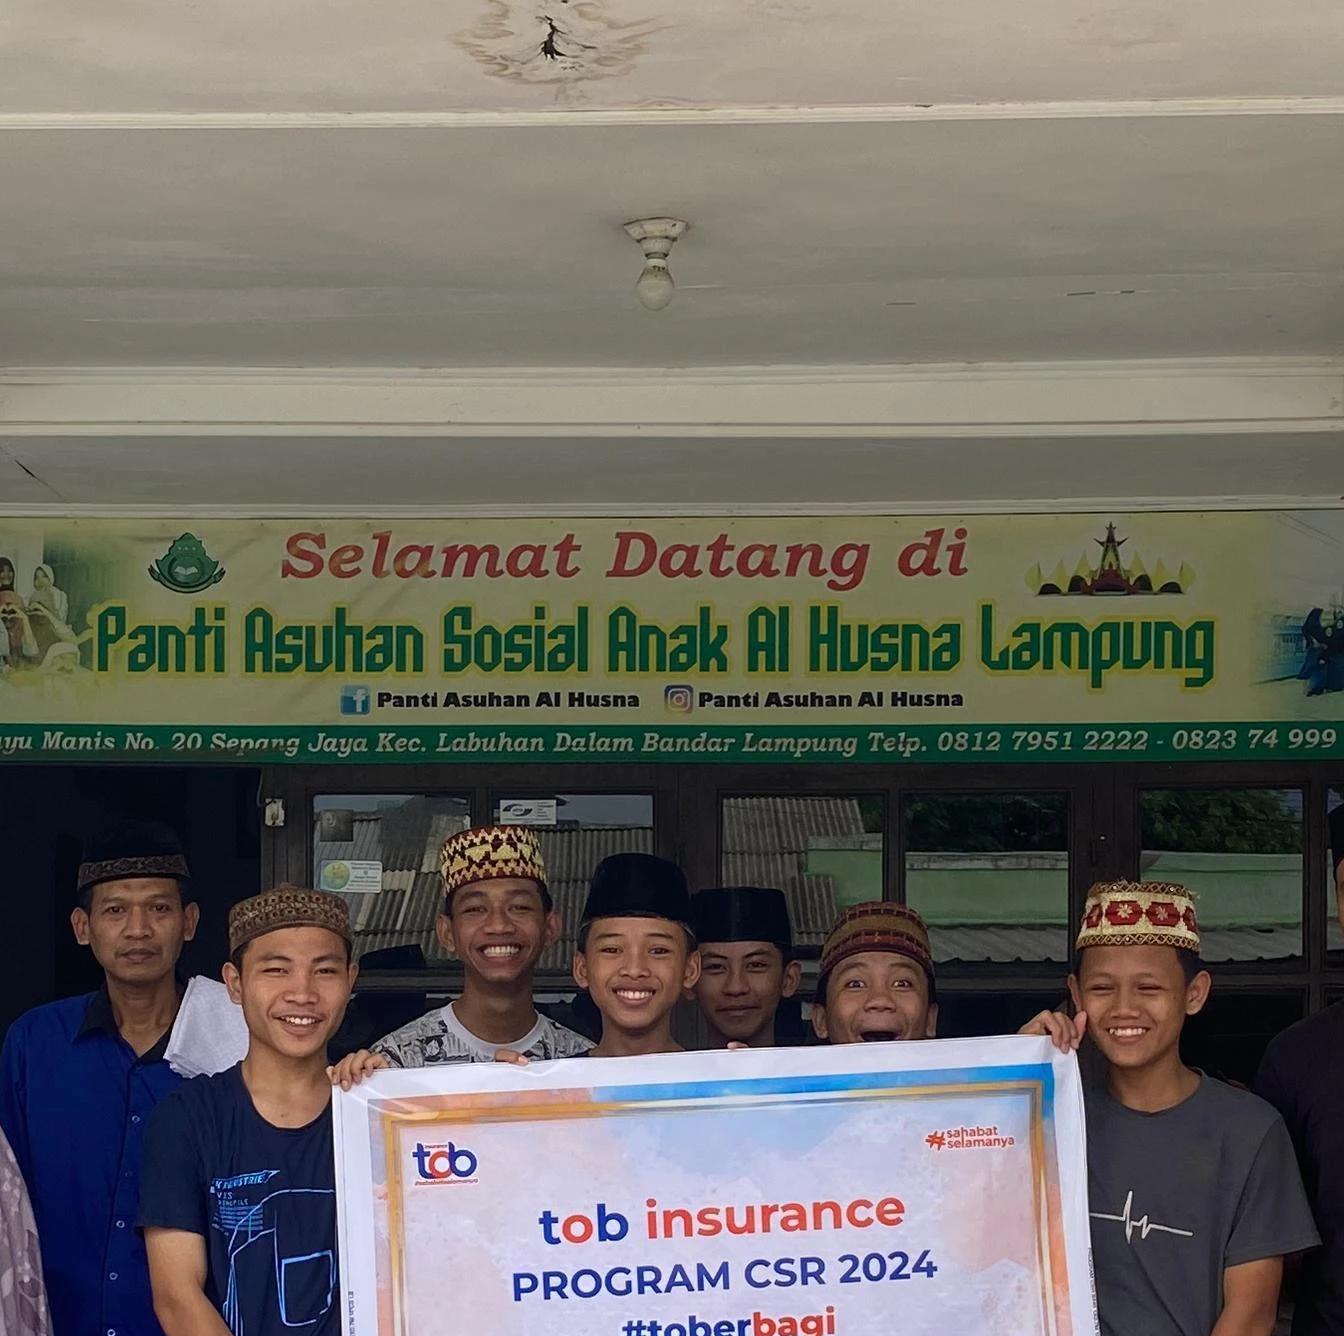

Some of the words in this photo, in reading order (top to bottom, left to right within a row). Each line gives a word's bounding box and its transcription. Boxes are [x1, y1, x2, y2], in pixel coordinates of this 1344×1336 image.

[282, 531, 582, 578] Selamat
[606, 530, 870, 591] Datang
[898, 528, 968, 576] di
[98, 606, 225, 672] Panti
[246, 606, 425, 673] Asuhan
[444, 606, 588, 672] Sosial
[608, 607, 727, 672] Anak
[748, 606, 789, 672] Al
[809, 606, 960, 672] Husna
[981, 604, 1214, 688] Lampung
[378, 692, 437, 707] Panti
[443, 692, 530, 707] Asuhan
[536, 692, 560, 707] Al
[569, 692, 639, 707] Husna
[699, 692, 759, 707] Panti
[764, 692, 852, 707] Asuhan
[858, 692, 883, 707] Al
[891, 692, 963, 707] Husna
[42, 731, 115, 750] Manis
[125, 733, 159, 749] No.
[172, 733, 202, 750] 20
[308, 733, 368, 757] Jaya
[376, 733, 425, 752] Kec.
[436, 732, 544, 752] Labuhan
[553, 732, 634, 751] Dalam
[641, 732, 735, 752] Bandar
[742, 733, 857, 757] Lampung
[868, 732, 926, 757] Telp.
[938, 732, 1001, 751] 0812
[1012, 731, 1072, 750] 7951
[1083, 731, 1148, 750] 2222
[1173, 730, 1236, 749] 0823
[1248, 729, 1278, 748] 74
[1289, 729, 1336, 748] 999
[539, 1203, 628, 1245] tob
[647, 1198, 905, 1239] insurance
[513, 1262, 730, 1301] PROGRAM
[745, 1257, 826, 1288] CSR
[838, 1250, 938, 1283] 2024
